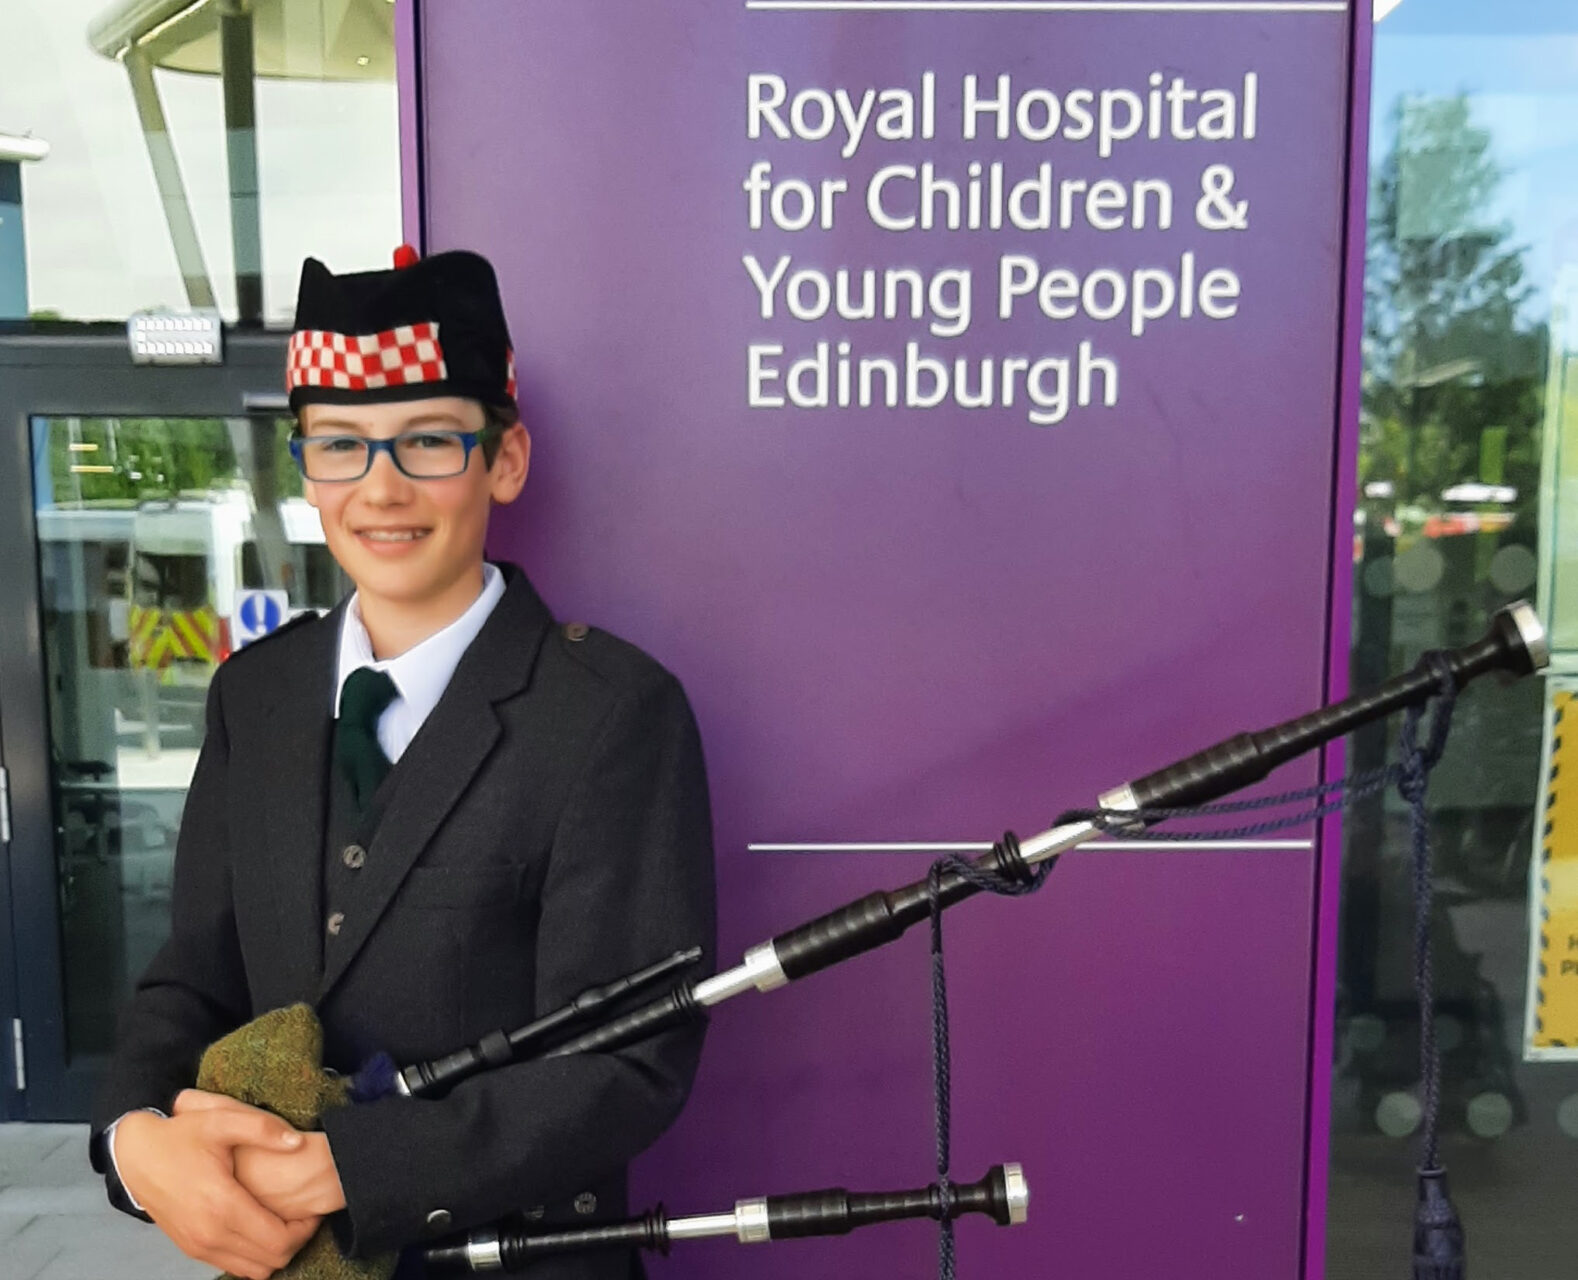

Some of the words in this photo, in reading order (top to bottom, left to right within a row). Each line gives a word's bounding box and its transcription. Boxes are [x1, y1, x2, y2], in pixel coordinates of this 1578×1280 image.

[747, 70, 936, 159] Royal
[962, 71, 1258, 158] Hospital
[743, 161, 848, 231] for
[866, 161, 1172, 231] Children
[1194, 163, 1249, 231] &
[742, 254, 972, 337] Young
[998, 251, 1242, 336] People
[747, 340, 1119, 425] Edinburgh
